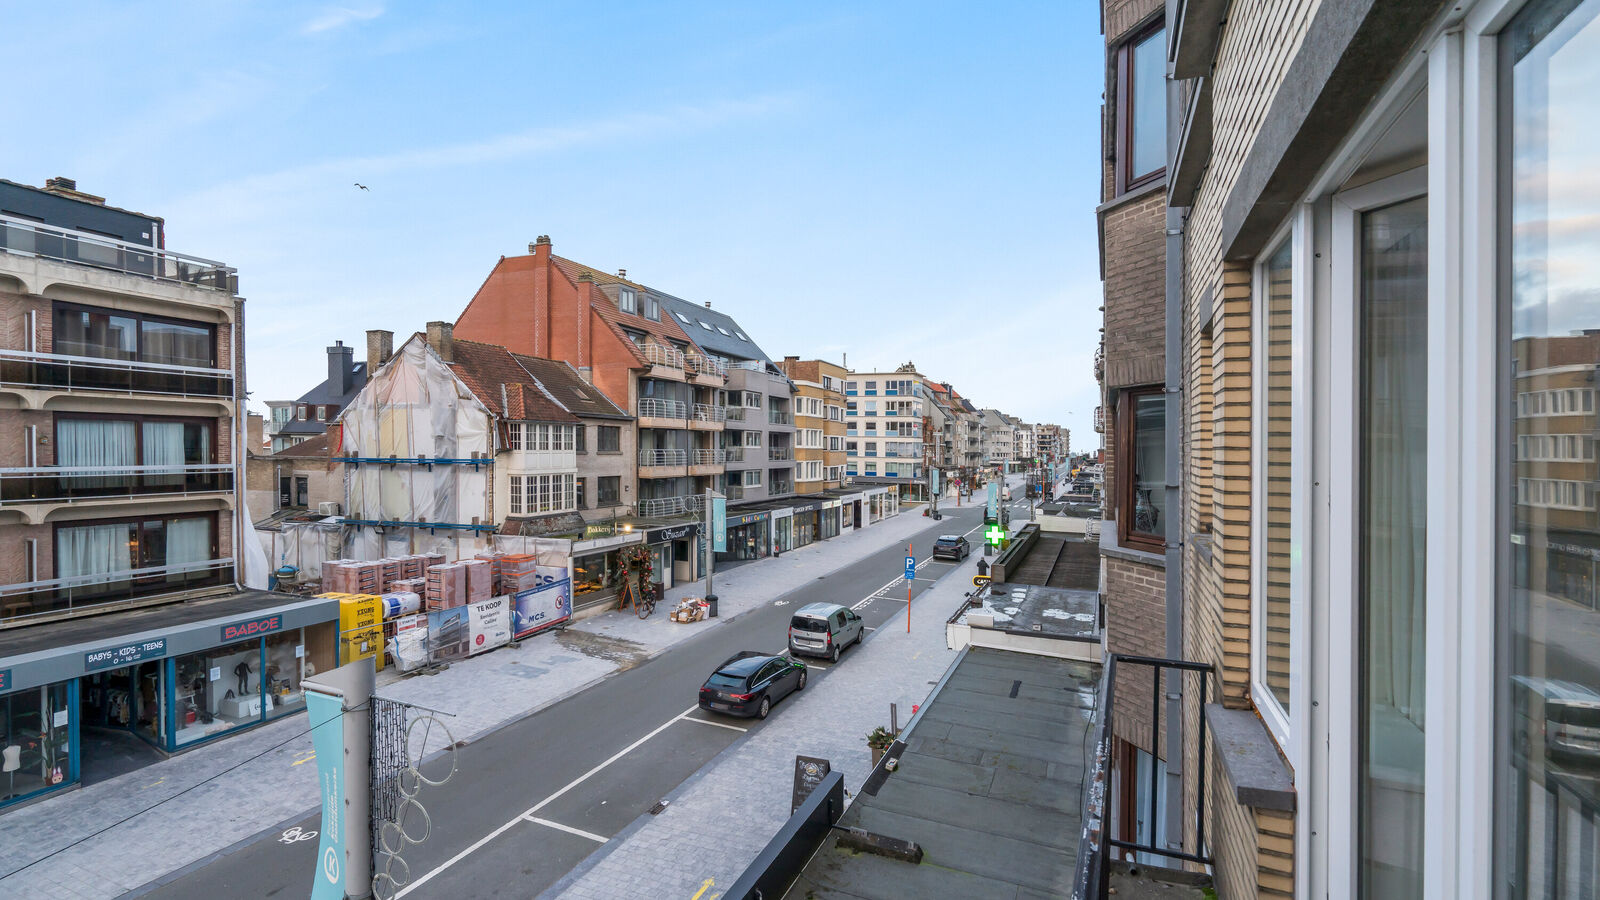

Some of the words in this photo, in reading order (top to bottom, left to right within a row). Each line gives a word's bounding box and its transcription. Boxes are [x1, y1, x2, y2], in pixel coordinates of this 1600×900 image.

[906, 558, 914, 569] P
[536, 574, 554, 587] CS
[477, 605, 485, 613] TE
[485, 600, 502, 611] KOOP
[528, 611, 545, 623] MCS
[225, 617, 279, 639] BABOE
[88, 651, 112, 663] BABYS
[119, 646, 136, 657] KIDS
[142, 640, 164, 652] TEENS
